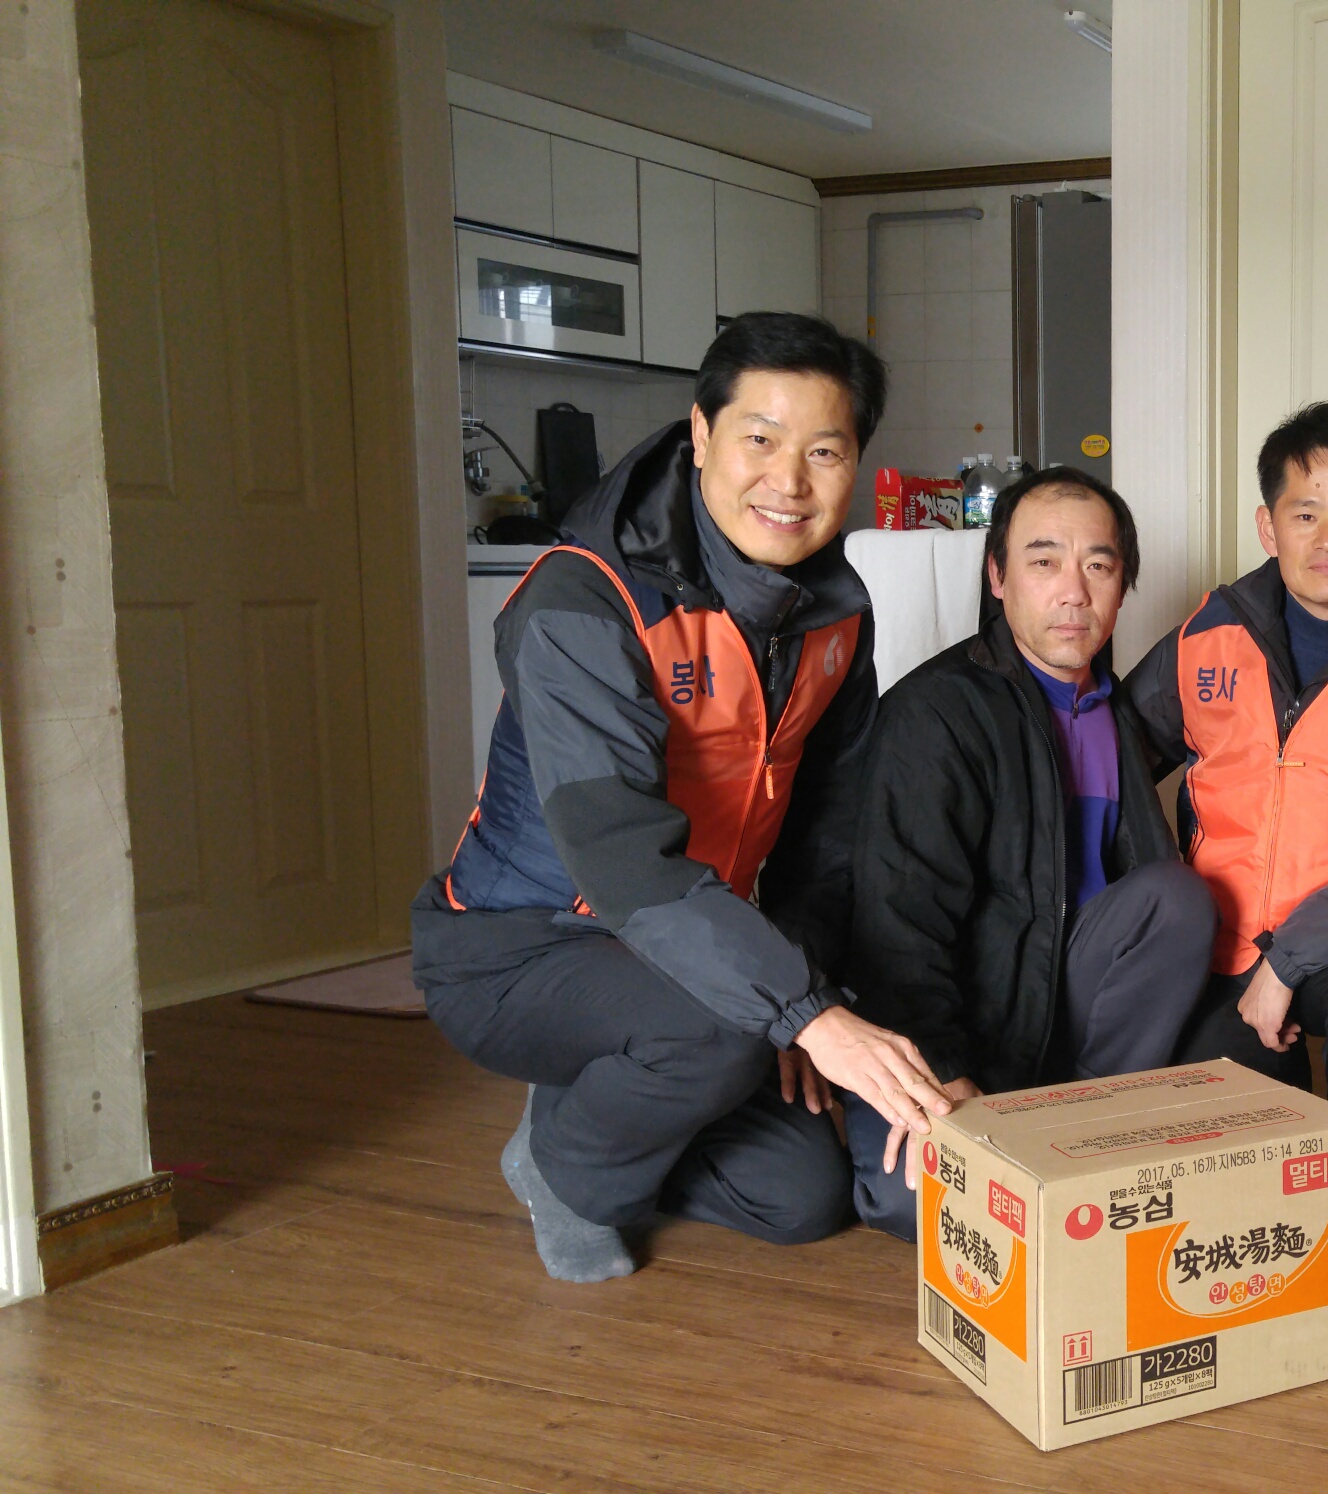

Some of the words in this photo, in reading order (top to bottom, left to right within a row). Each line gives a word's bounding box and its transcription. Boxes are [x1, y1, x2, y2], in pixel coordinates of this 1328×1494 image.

[1196, 667, 1238, 703] 봉사
[1261, 1143, 1292, 1162] 15:14
[1299, 1138, 1324, 1155] 2931
[940, 1154, 966, 1194] 농심
[1109, 1188, 1127, 1201] 믿을
[1155, 1179, 1173, 1192] 식품
[991, 1186, 1023, 1231] 멀티팩
[1108, 1191, 1174, 1230] 농심
[1173, 1222, 1310, 1284] 安城湯麵
[956, 1265, 989, 1307] 안성탕면
[1210, 1275, 1284, 1304] 안성탕면
[954, 1315, 985, 1356] 가2280
[1144, 1342, 1213, 1376] 가2280
